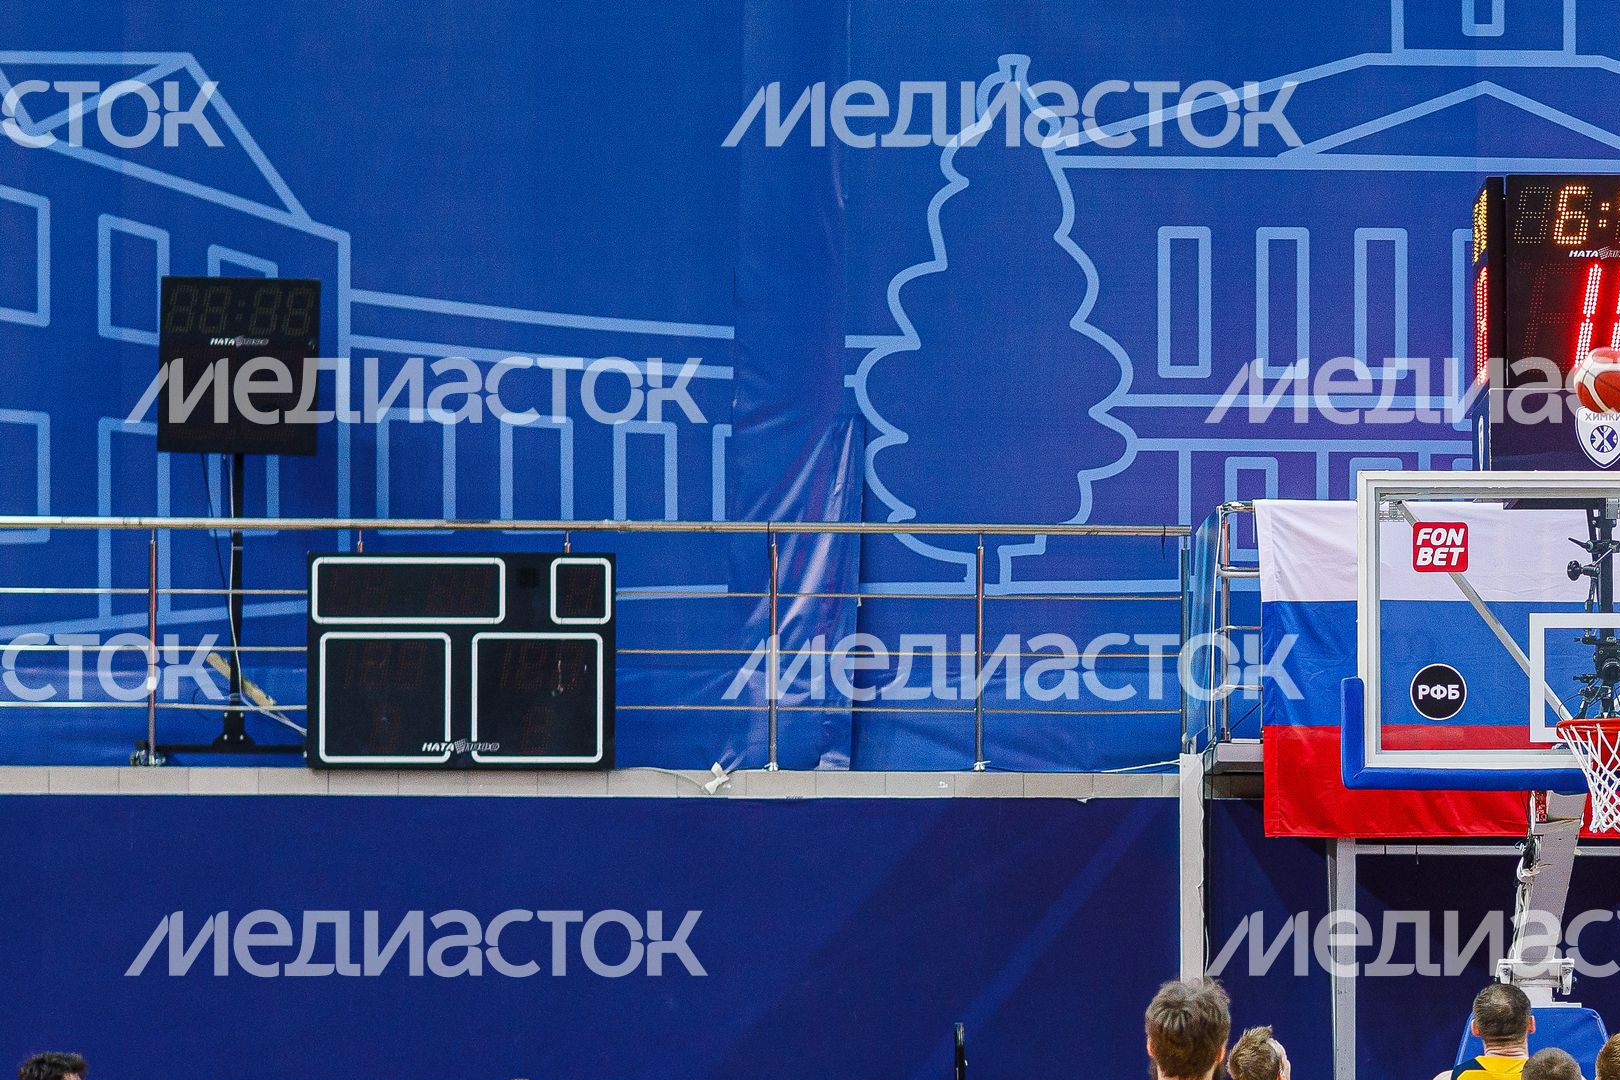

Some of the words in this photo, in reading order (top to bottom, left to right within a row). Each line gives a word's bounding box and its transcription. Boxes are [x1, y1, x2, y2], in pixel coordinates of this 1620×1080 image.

[1416, 528, 1465, 545] FON
[1416, 547, 1465, 566] BET
[1418, 684, 1460, 700] РФБ
